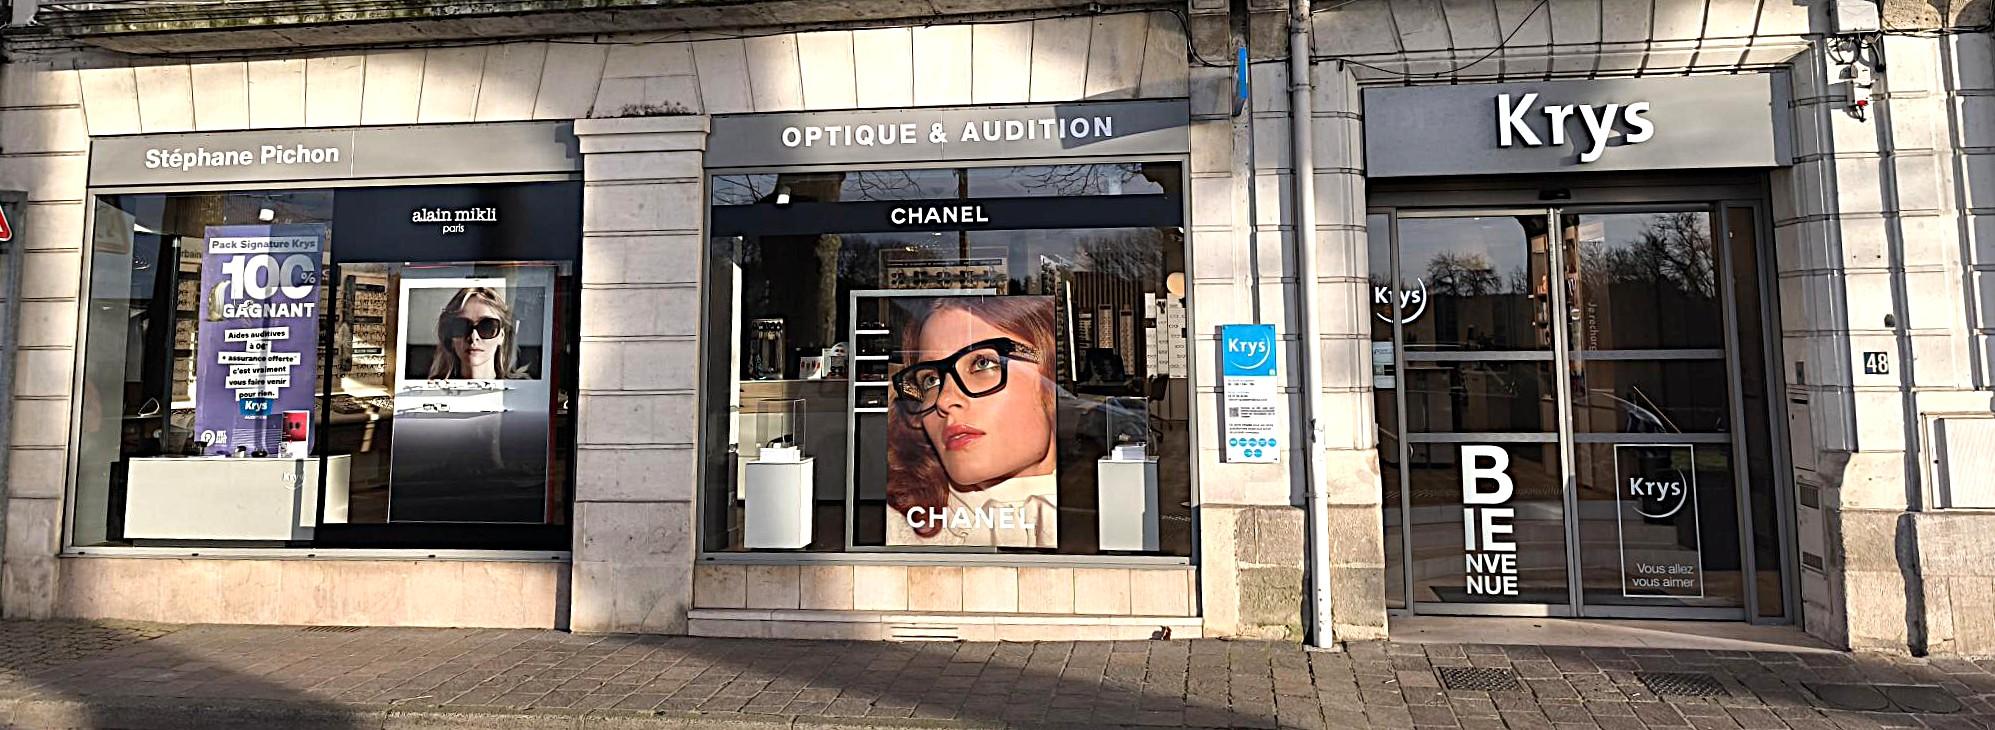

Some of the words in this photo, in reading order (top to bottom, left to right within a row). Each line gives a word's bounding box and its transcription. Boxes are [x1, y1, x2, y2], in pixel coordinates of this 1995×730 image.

[781, 123, 918, 147] OPTIQUE
[927, 122, 948, 144] &
[960, 116, 1114, 143] AUDITION
[1496, 92, 1656, 164] Krys
[145, 147, 254, 171] Stéphane
[260, 144, 340, 165] Pichon
[412, 208, 453, 222] alain
[454, 207, 498, 222] mikli
[890, 205, 989, 226] CHANEL
[442, 224, 465, 235] paris
[212, 240, 238, 249] Pack
[239, 239, 290, 250] Signature
[291, 238, 317, 250] Krys
[222, 302, 315, 318] GAGNANT
[228, 331, 249, 340] Aides
[250, 330, 286, 338] auditives
[249, 342, 255, 350] à
[1228, 338, 1266, 357] Krys
[232, 367, 251, 375] c'est
[252, 365, 287, 374] vraiment
[1866, 353, 1888, 373] 48
[248, 378, 266, 386] faire
[238, 392, 257, 400] pour
[244, 400, 268, 412] Krys
[1461, 445, 1514, 504] B
[1629, 477, 1681, 501] Krys
[906, 506, 1036, 529] CHANEL
[1463, 507, 1517, 551] IE
[1465, 553, 1518, 574] NVE
[1636, 562, 1666, 574] Vous
[1667, 562, 1694, 574] allez
[1466, 575, 1519, 595] NUE
[1632, 577, 1660, 587] vous
[1663, 576, 1694, 587] aimer
